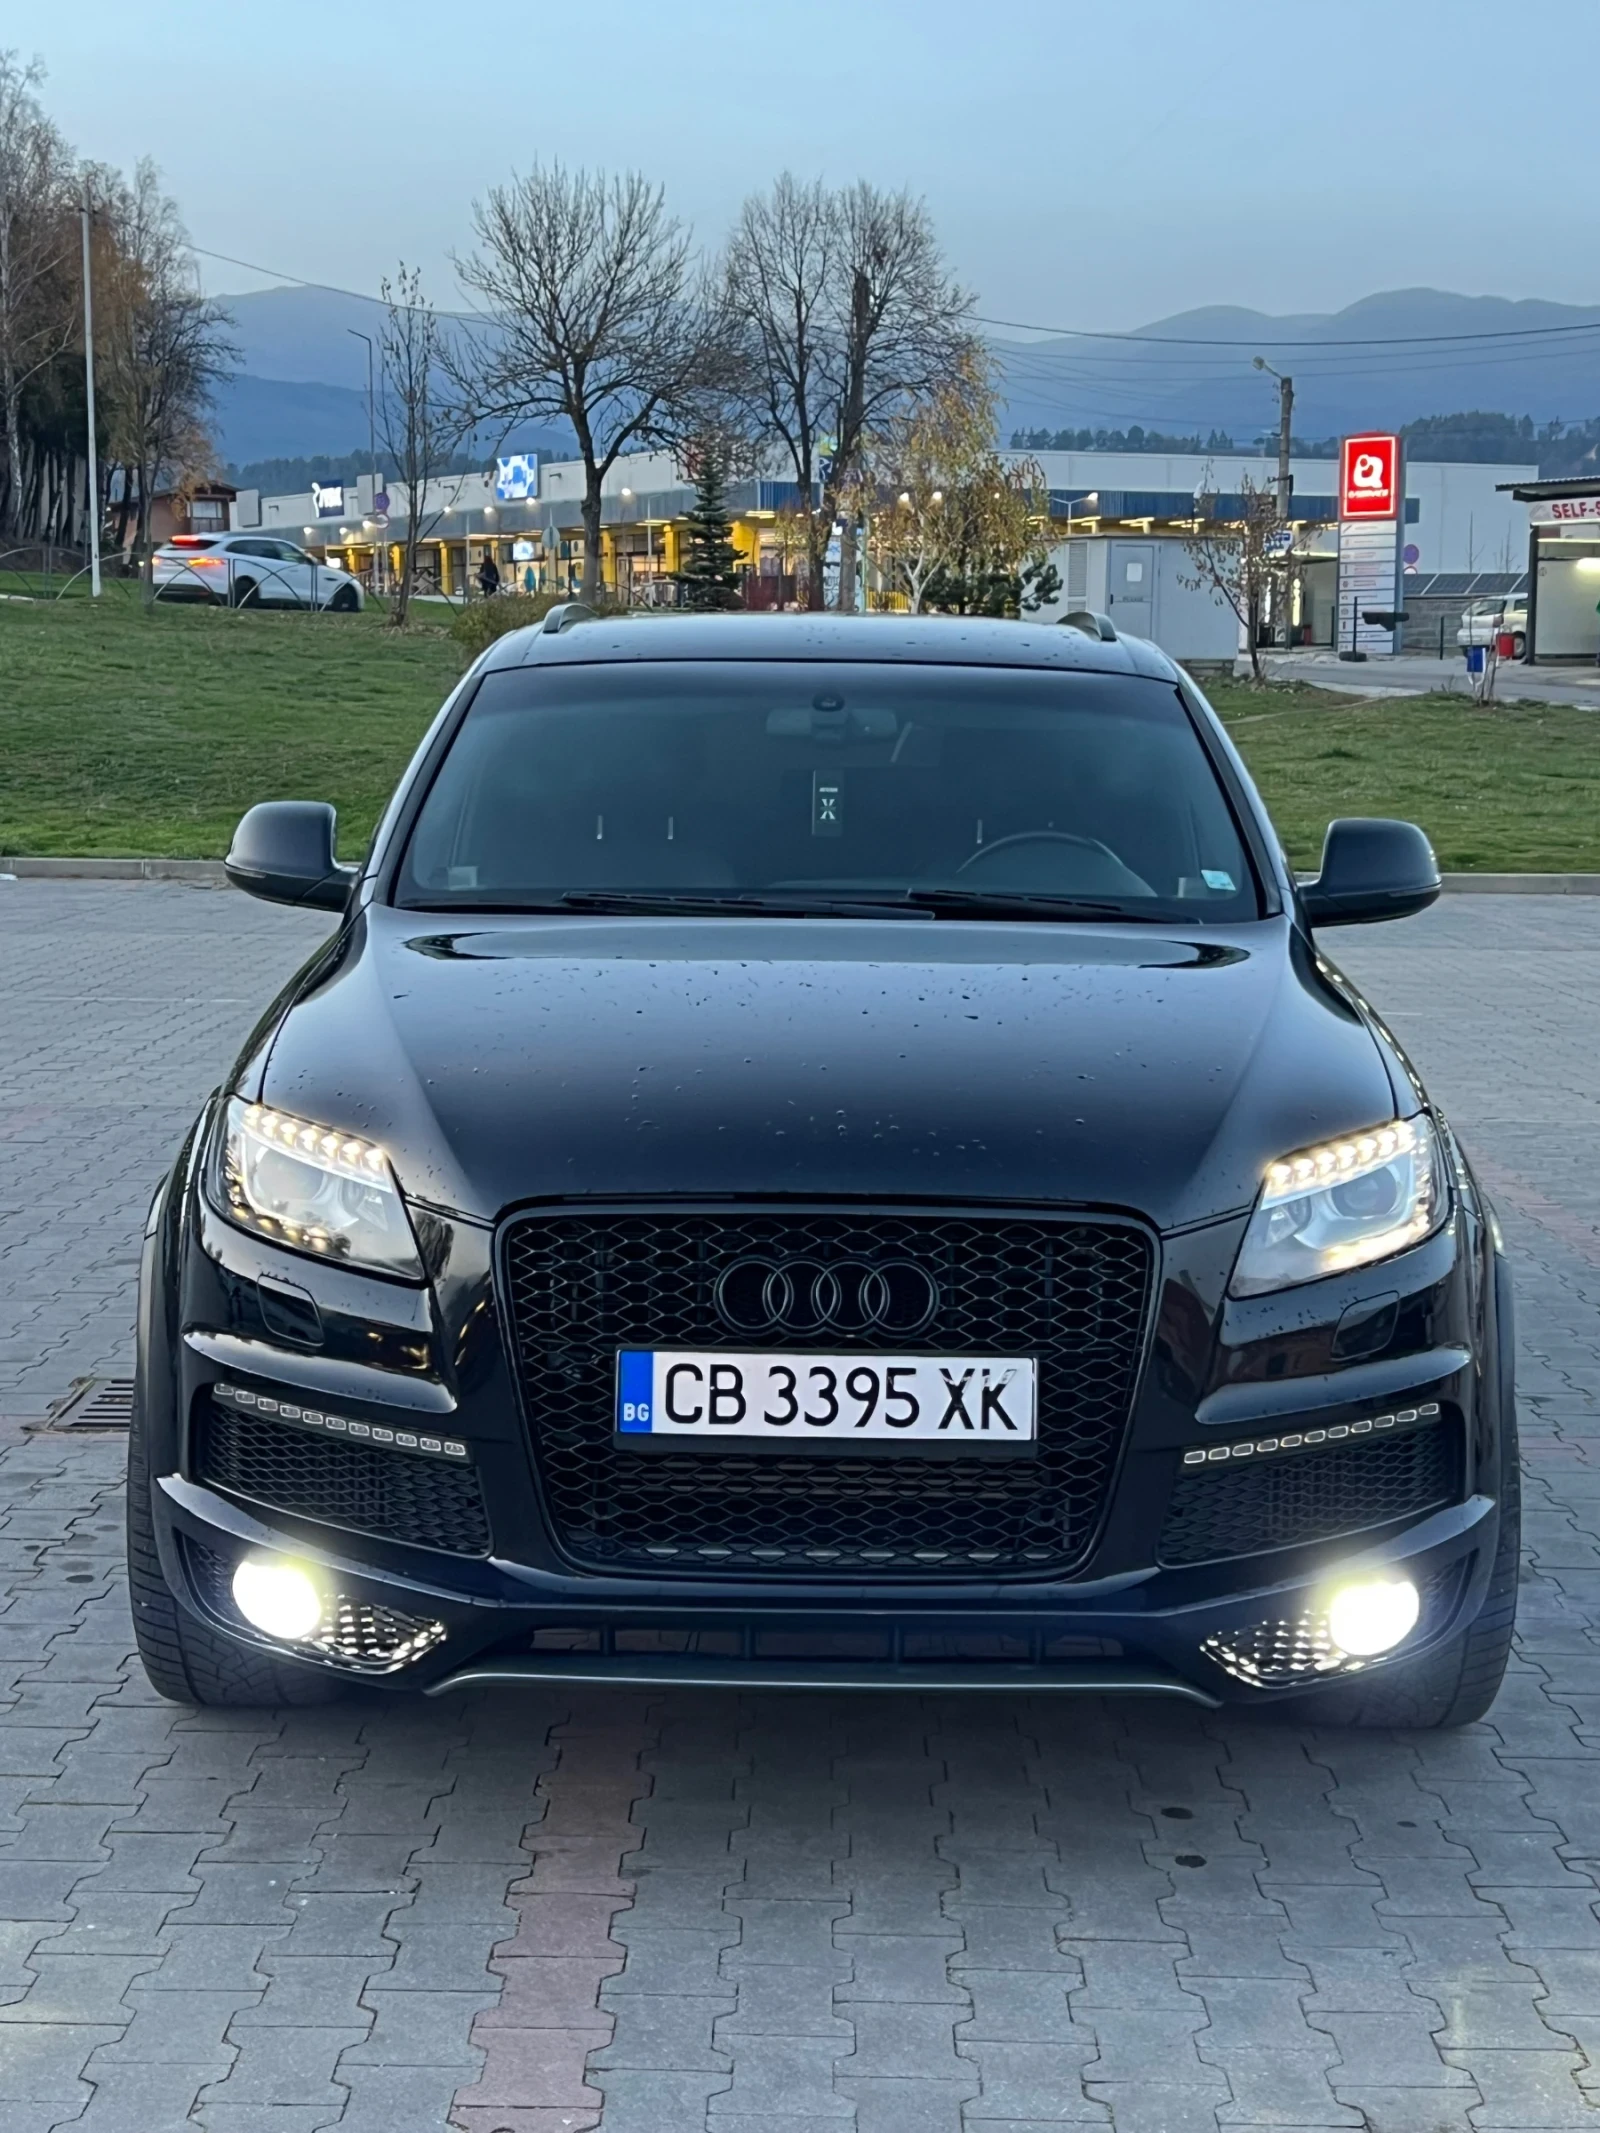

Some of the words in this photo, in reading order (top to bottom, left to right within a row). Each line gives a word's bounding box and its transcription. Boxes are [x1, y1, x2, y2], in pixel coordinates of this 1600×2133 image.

[623, 1403, 649, 1421] BG
[664, 1363, 747, 1426] CB
[763, 1365, 920, 1429] 3395
[937, 1367, 1019, 1431] XK
